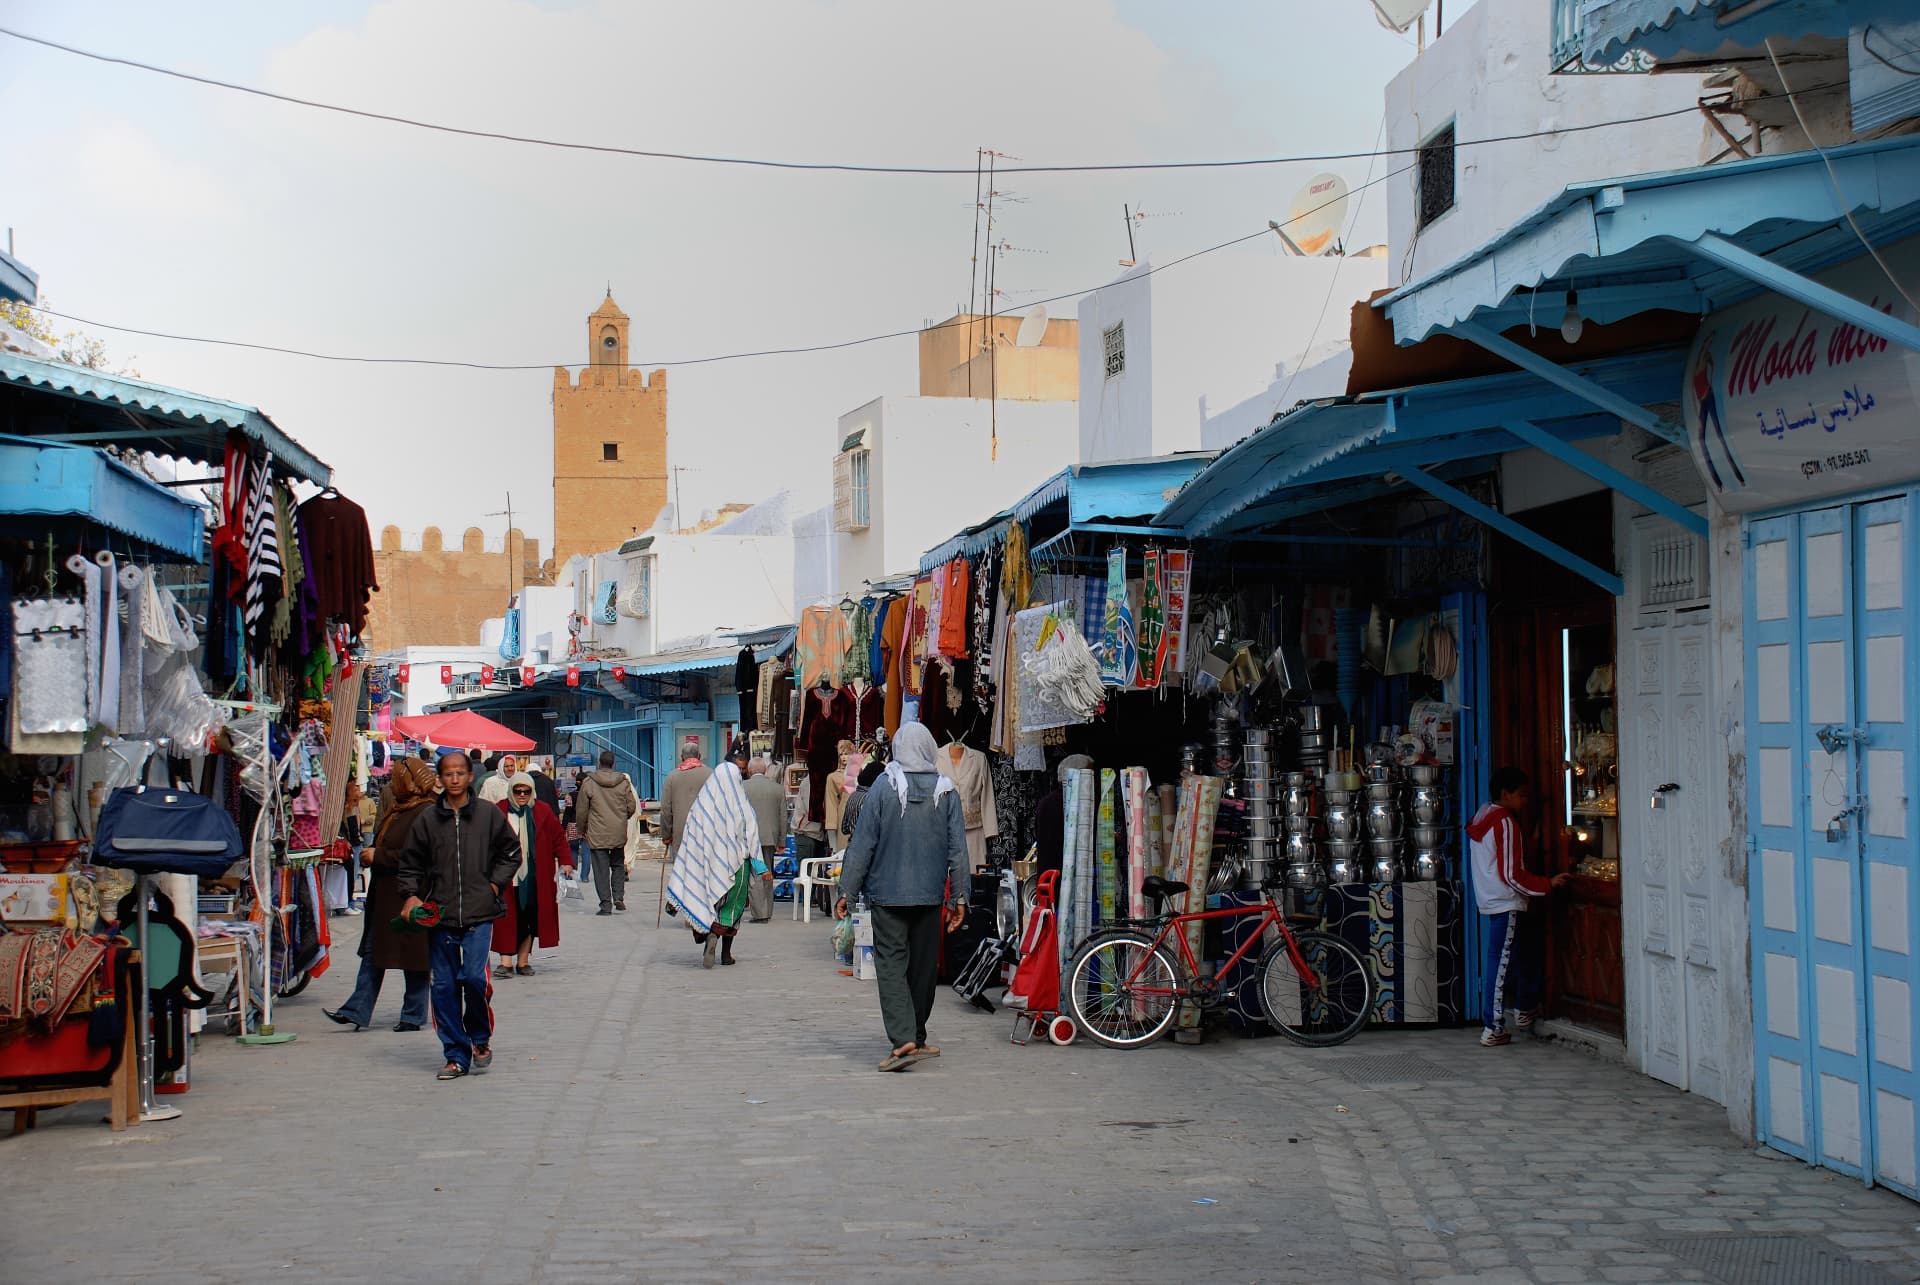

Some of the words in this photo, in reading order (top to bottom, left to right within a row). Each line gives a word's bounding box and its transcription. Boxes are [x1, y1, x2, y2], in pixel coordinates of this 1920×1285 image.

[1728, 310, 1817, 397] Moda
[1756, 403, 1817, 440] نسائية
[1823, 384, 1875, 432] ملابس
